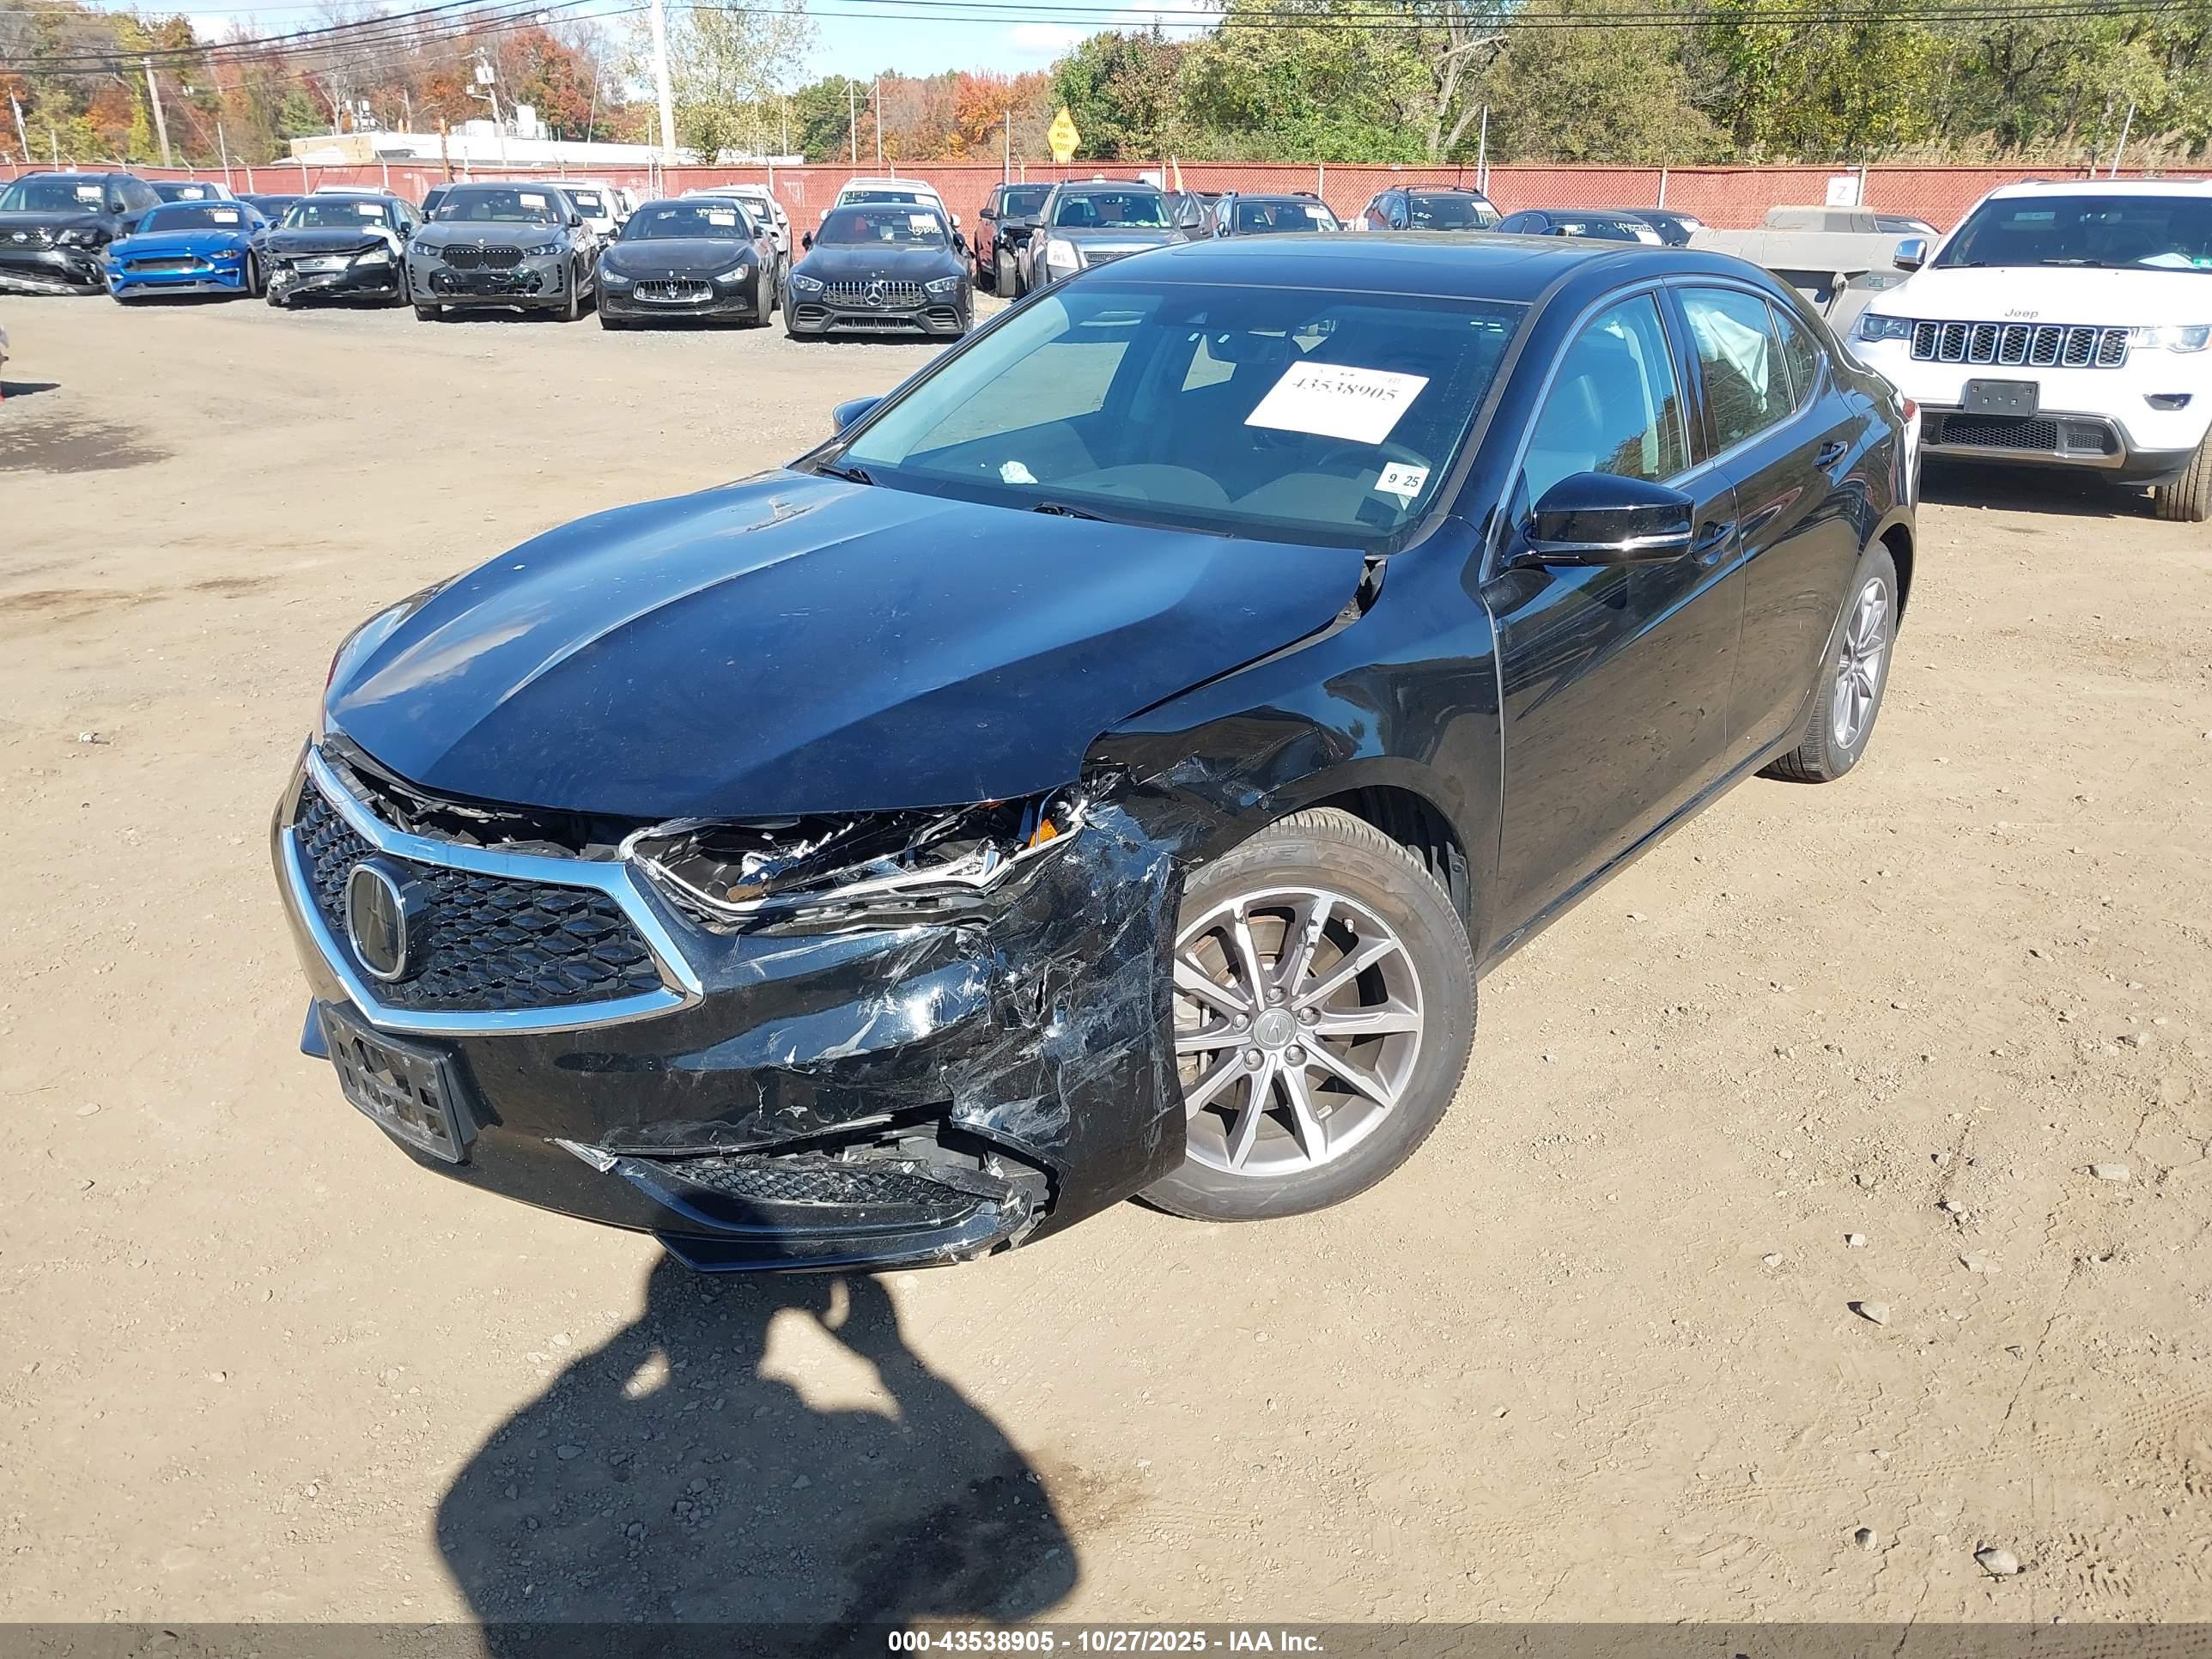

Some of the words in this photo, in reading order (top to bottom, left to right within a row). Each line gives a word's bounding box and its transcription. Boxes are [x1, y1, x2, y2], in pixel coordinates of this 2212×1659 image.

[1836, 185, 1848, 200] Z
[2004, 308, 2039, 319] Jeep
[1292, 377, 1401, 401] 43538905
[1388, 473, 1398, 483] 9
[1402, 475, 1421, 488] 25
